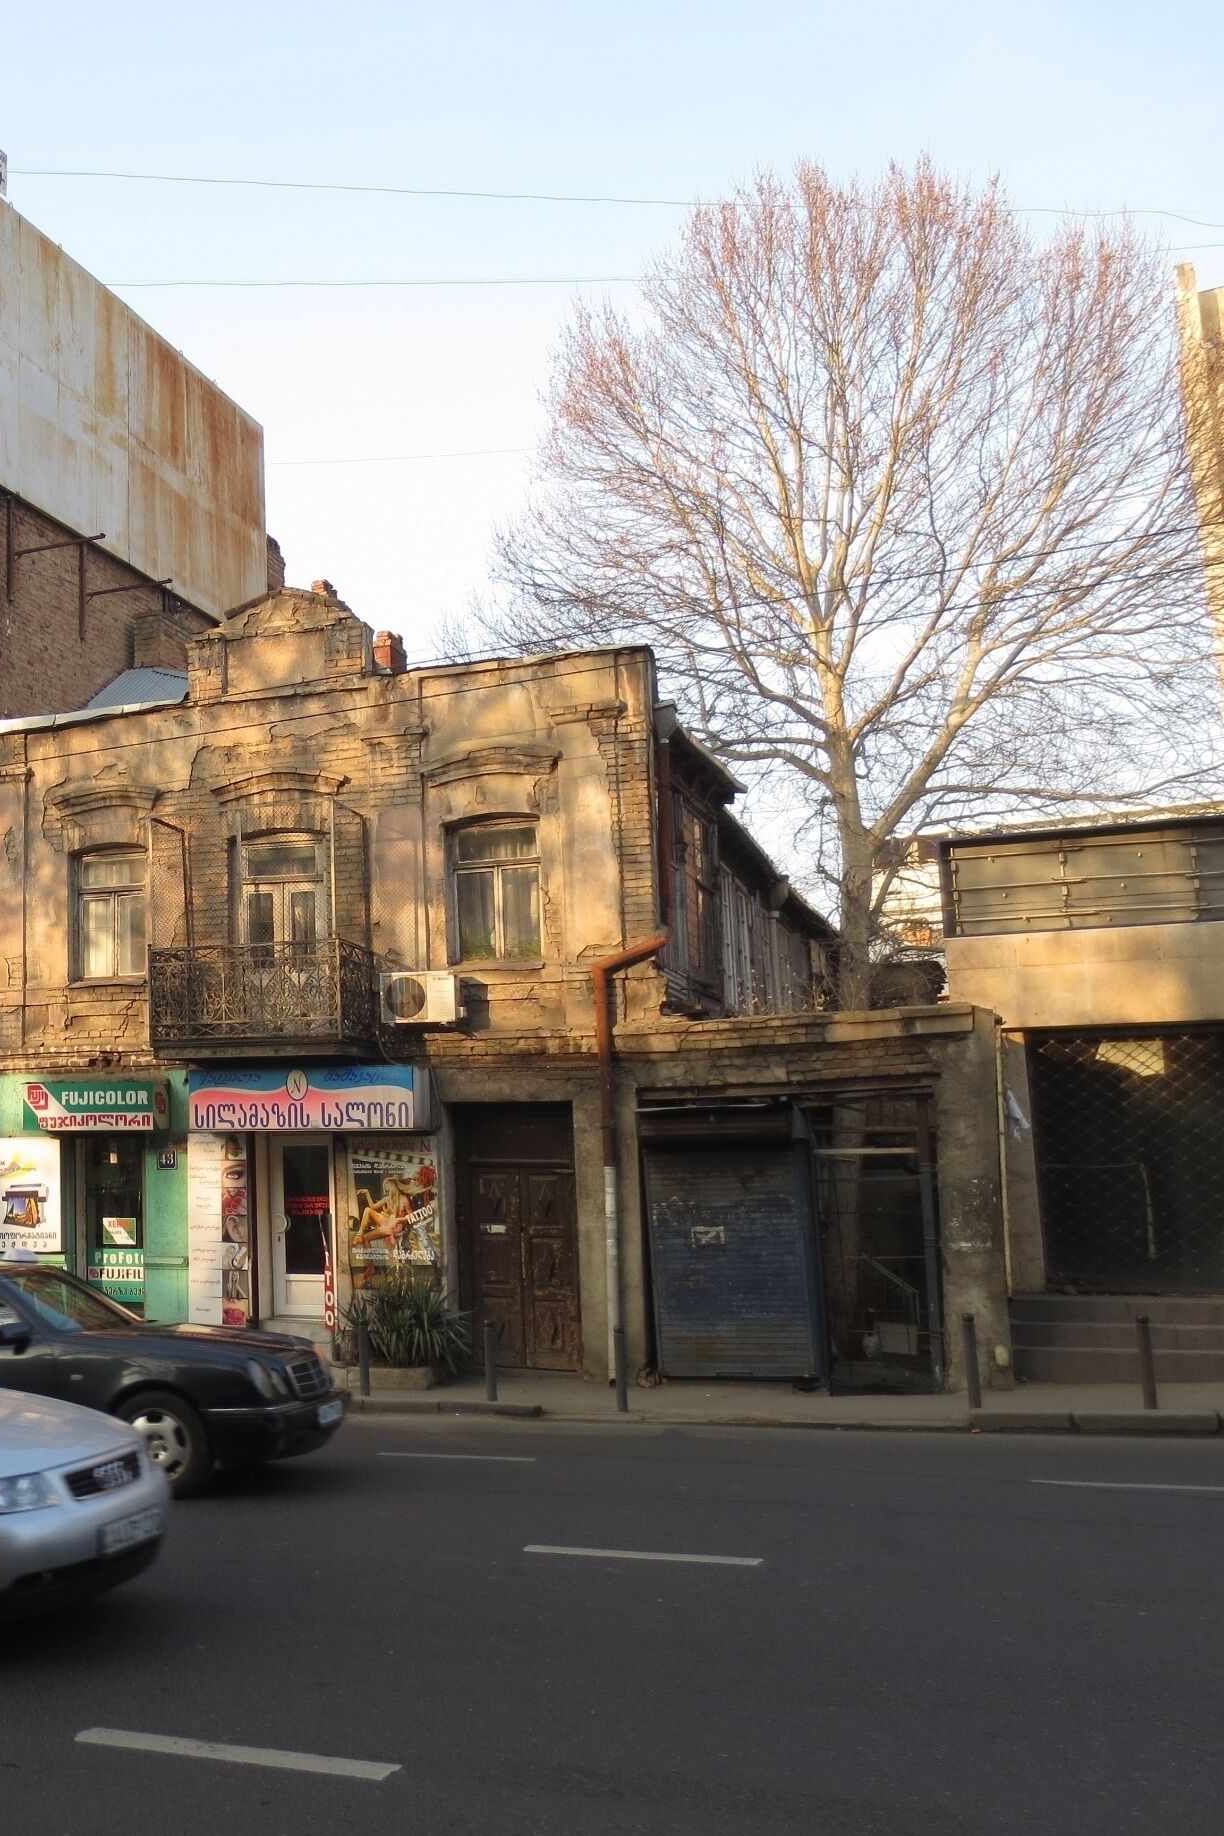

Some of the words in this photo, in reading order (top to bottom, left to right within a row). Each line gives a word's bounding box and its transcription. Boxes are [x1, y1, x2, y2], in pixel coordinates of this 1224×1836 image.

[61, 1090, 148, 1106] FUJICOLOR
[39, 1114, 151, 1129] ფუჯიკოლორი
[194, 1101, 310, 1128] სილამაზის
[321, 1101, 410, 1128] სალონი
[420, 1139, 432, 1153] N
[159, 1152, 174, 1166] 43
[406, 1204, 433, 1225] TATTOO
